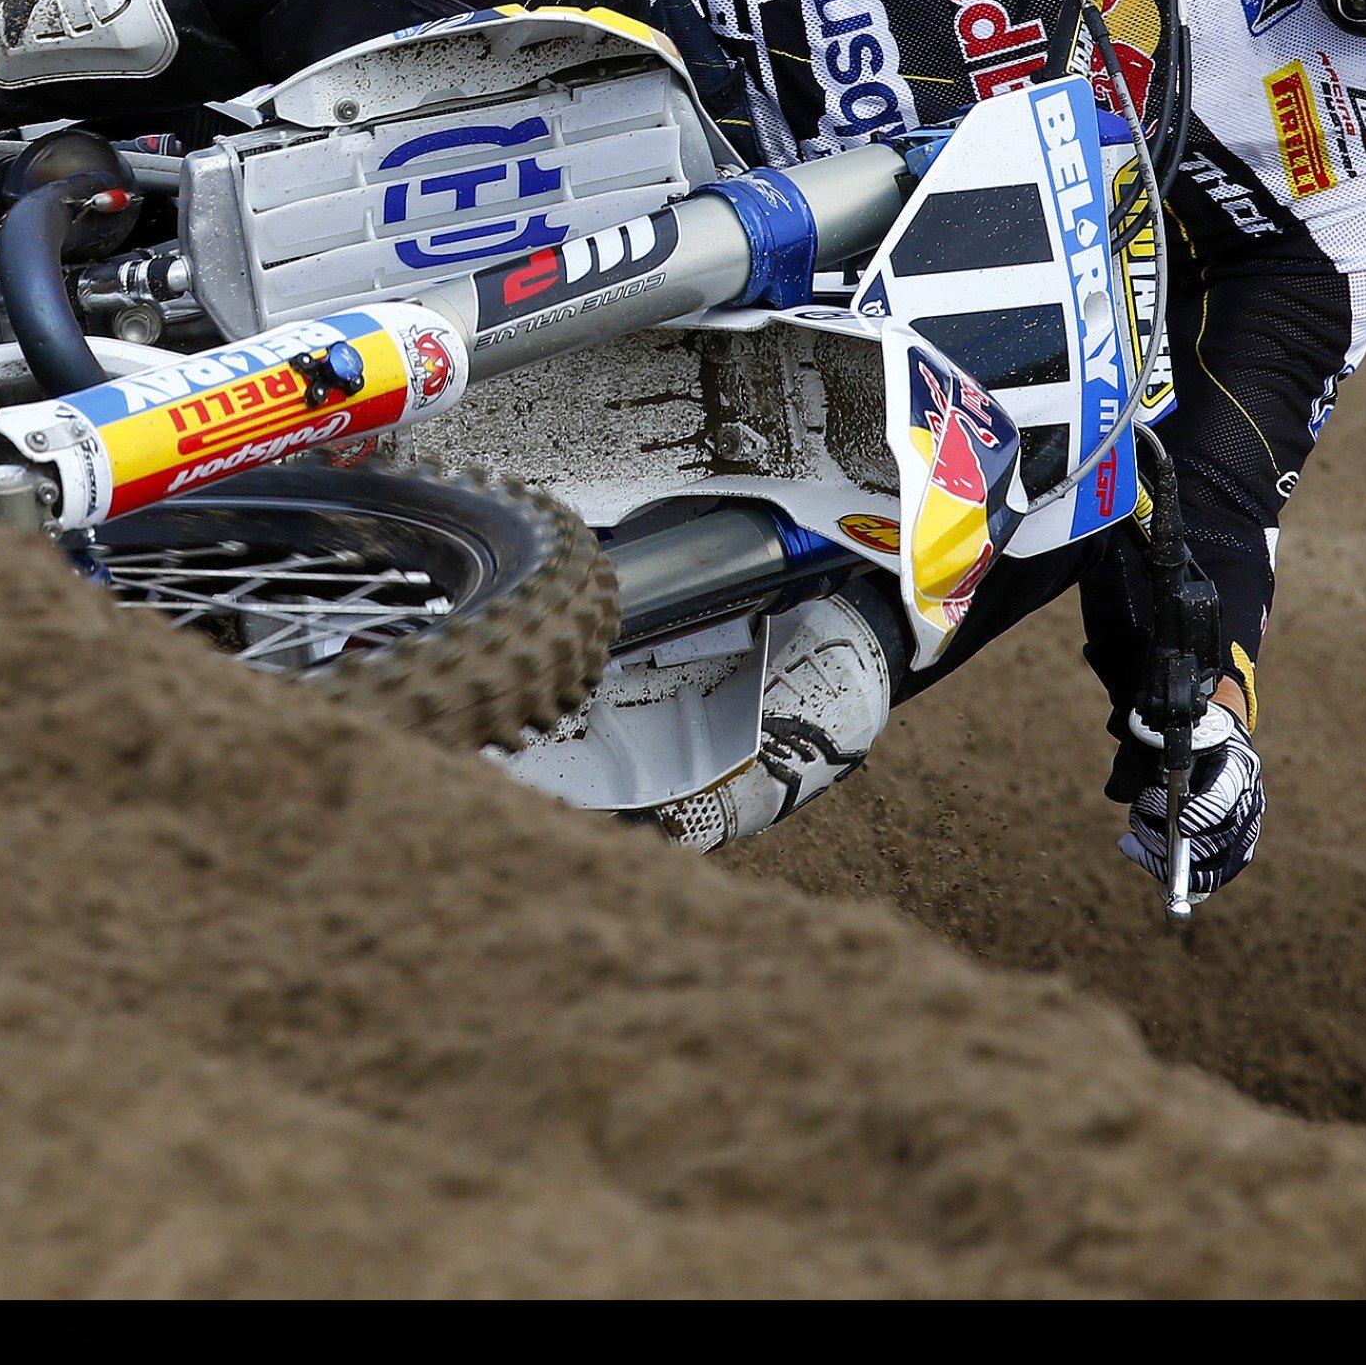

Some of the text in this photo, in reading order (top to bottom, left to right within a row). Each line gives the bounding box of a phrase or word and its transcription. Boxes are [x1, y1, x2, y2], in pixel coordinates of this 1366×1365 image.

[1271, 72, 1332, 196] PIRELLI
[473, 272, 667, 352] CONE VALVE
[168, 369, 301, 433] RELLI
[167, 410, 352, 493] Polisport
[1096, 397, 1120, 518] MGP
